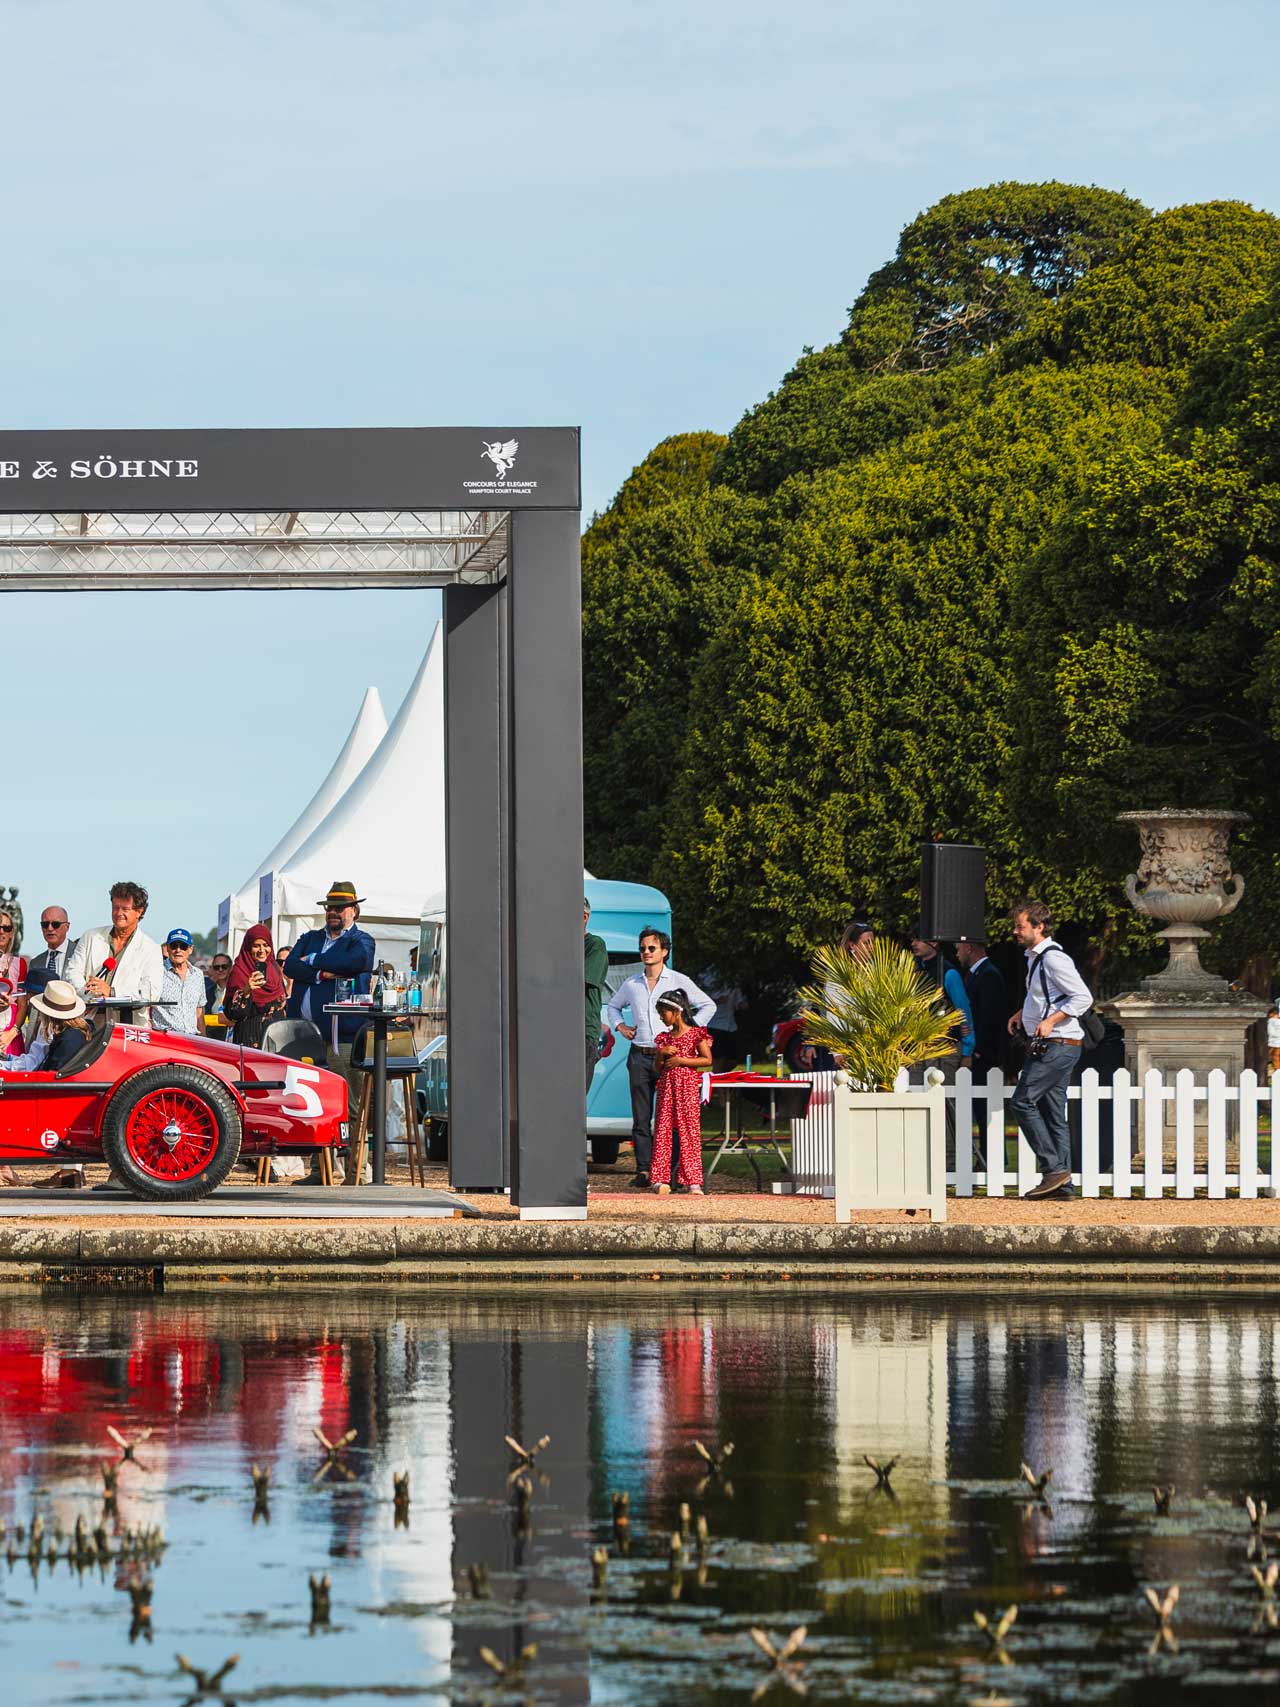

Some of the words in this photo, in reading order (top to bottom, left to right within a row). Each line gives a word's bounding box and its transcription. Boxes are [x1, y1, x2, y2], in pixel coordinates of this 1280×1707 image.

[32, 461, 57, 479] &
[70, 455, 198, 479] SÖHNE
[281, 1065, 324, 1118] 5
[44, 1132, 56, 1147] E
